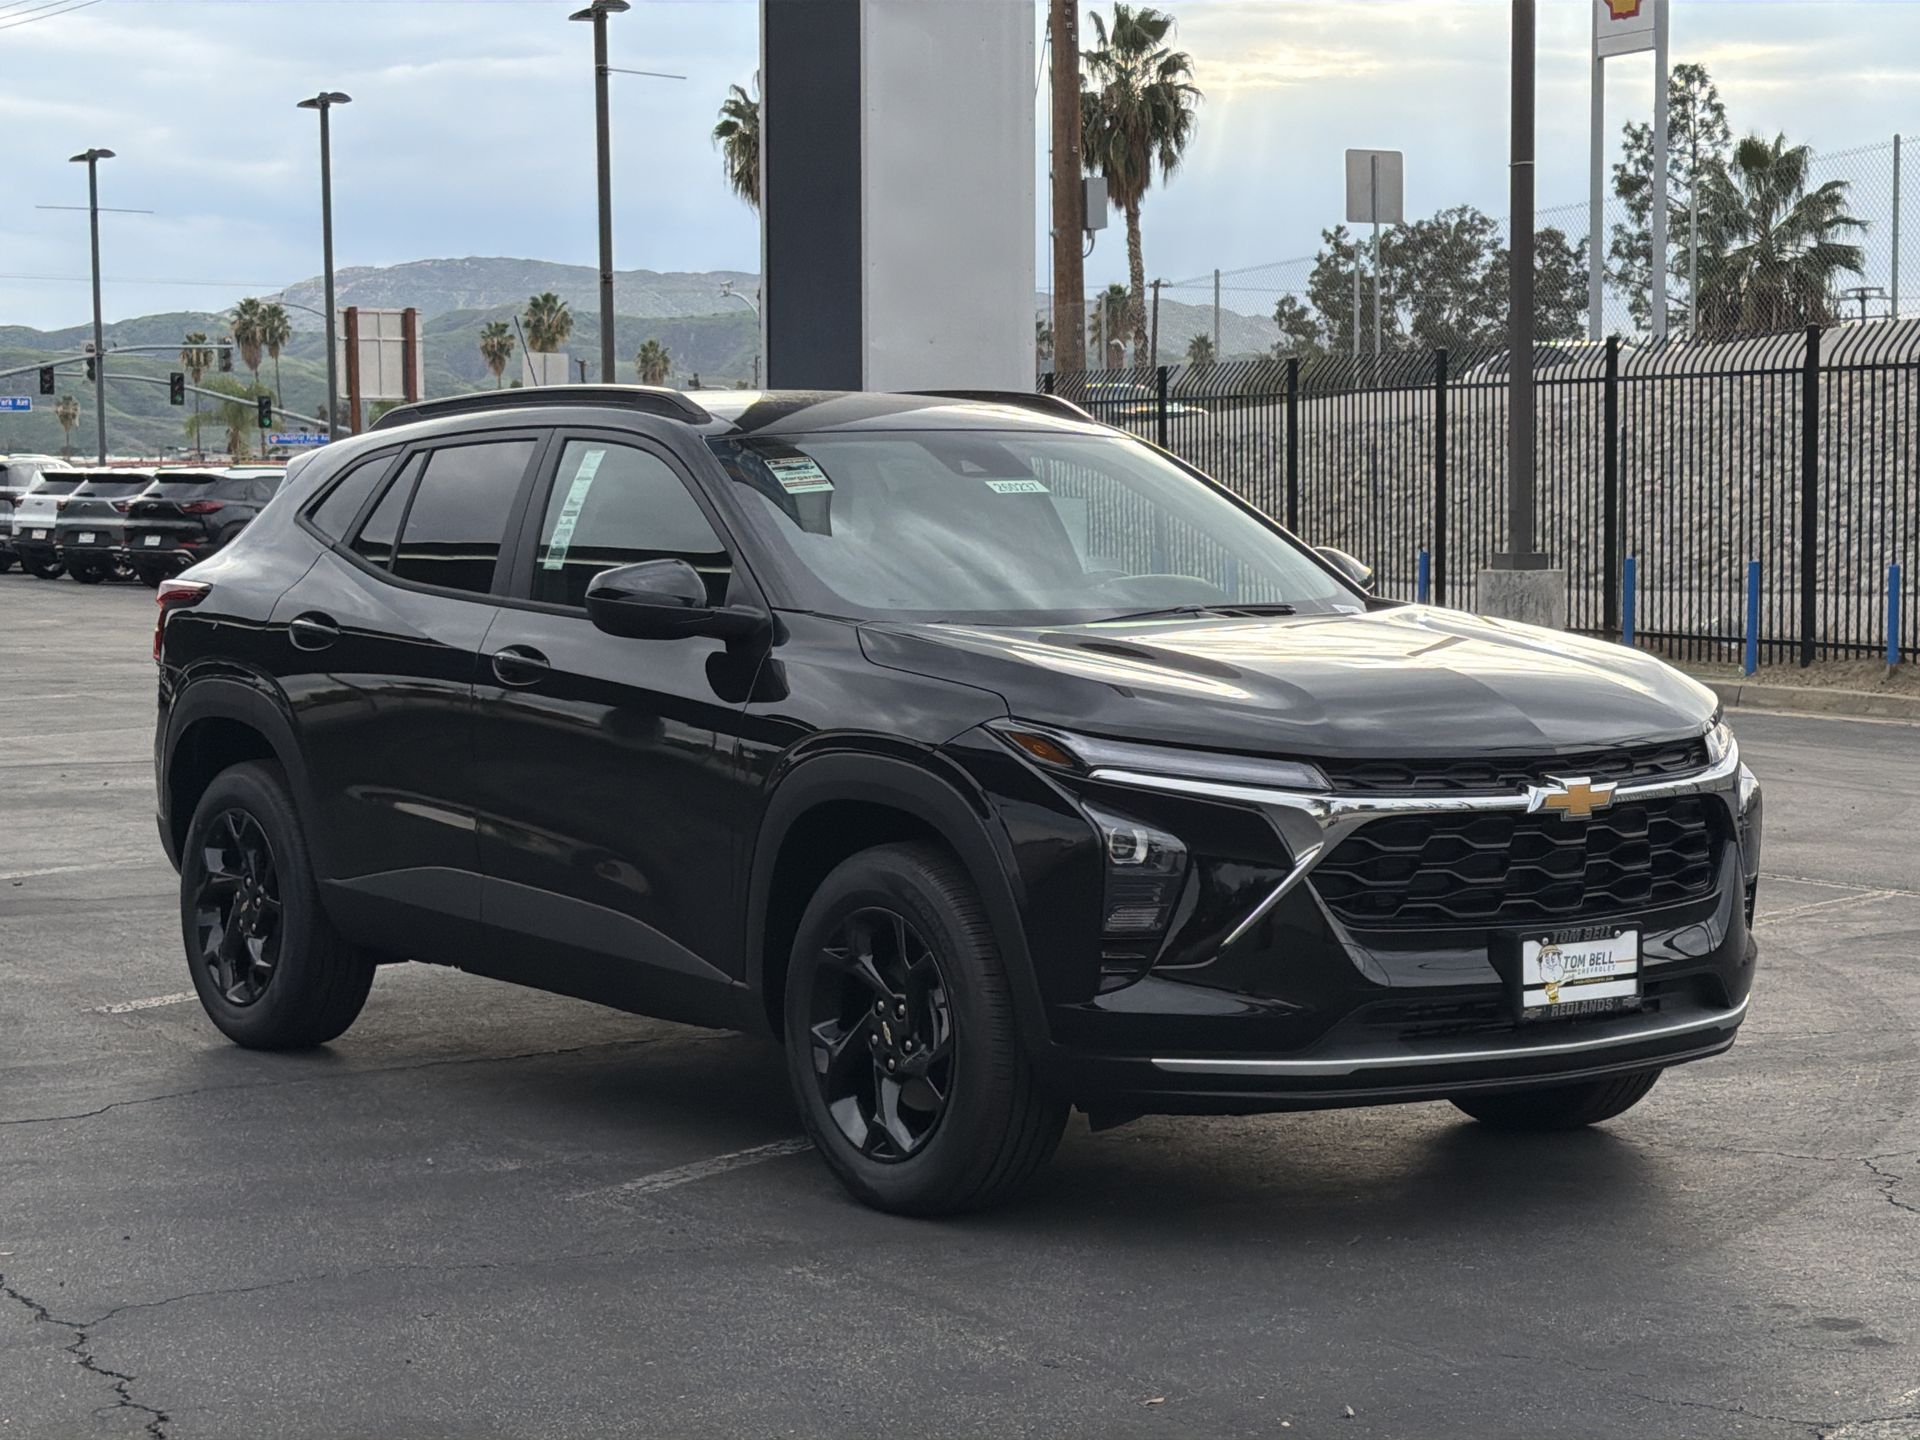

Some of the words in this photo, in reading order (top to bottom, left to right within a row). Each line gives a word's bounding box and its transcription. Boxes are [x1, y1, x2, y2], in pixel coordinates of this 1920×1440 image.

[1552, 928, 1581, 943] TOM
[1584, 926, 1613, 940] BELL
[1563, 954, 1586, 969] TOM
[1589, 951, 1614, 966] BELL
[1551, 999, 1614, 1017] REDLANDS
